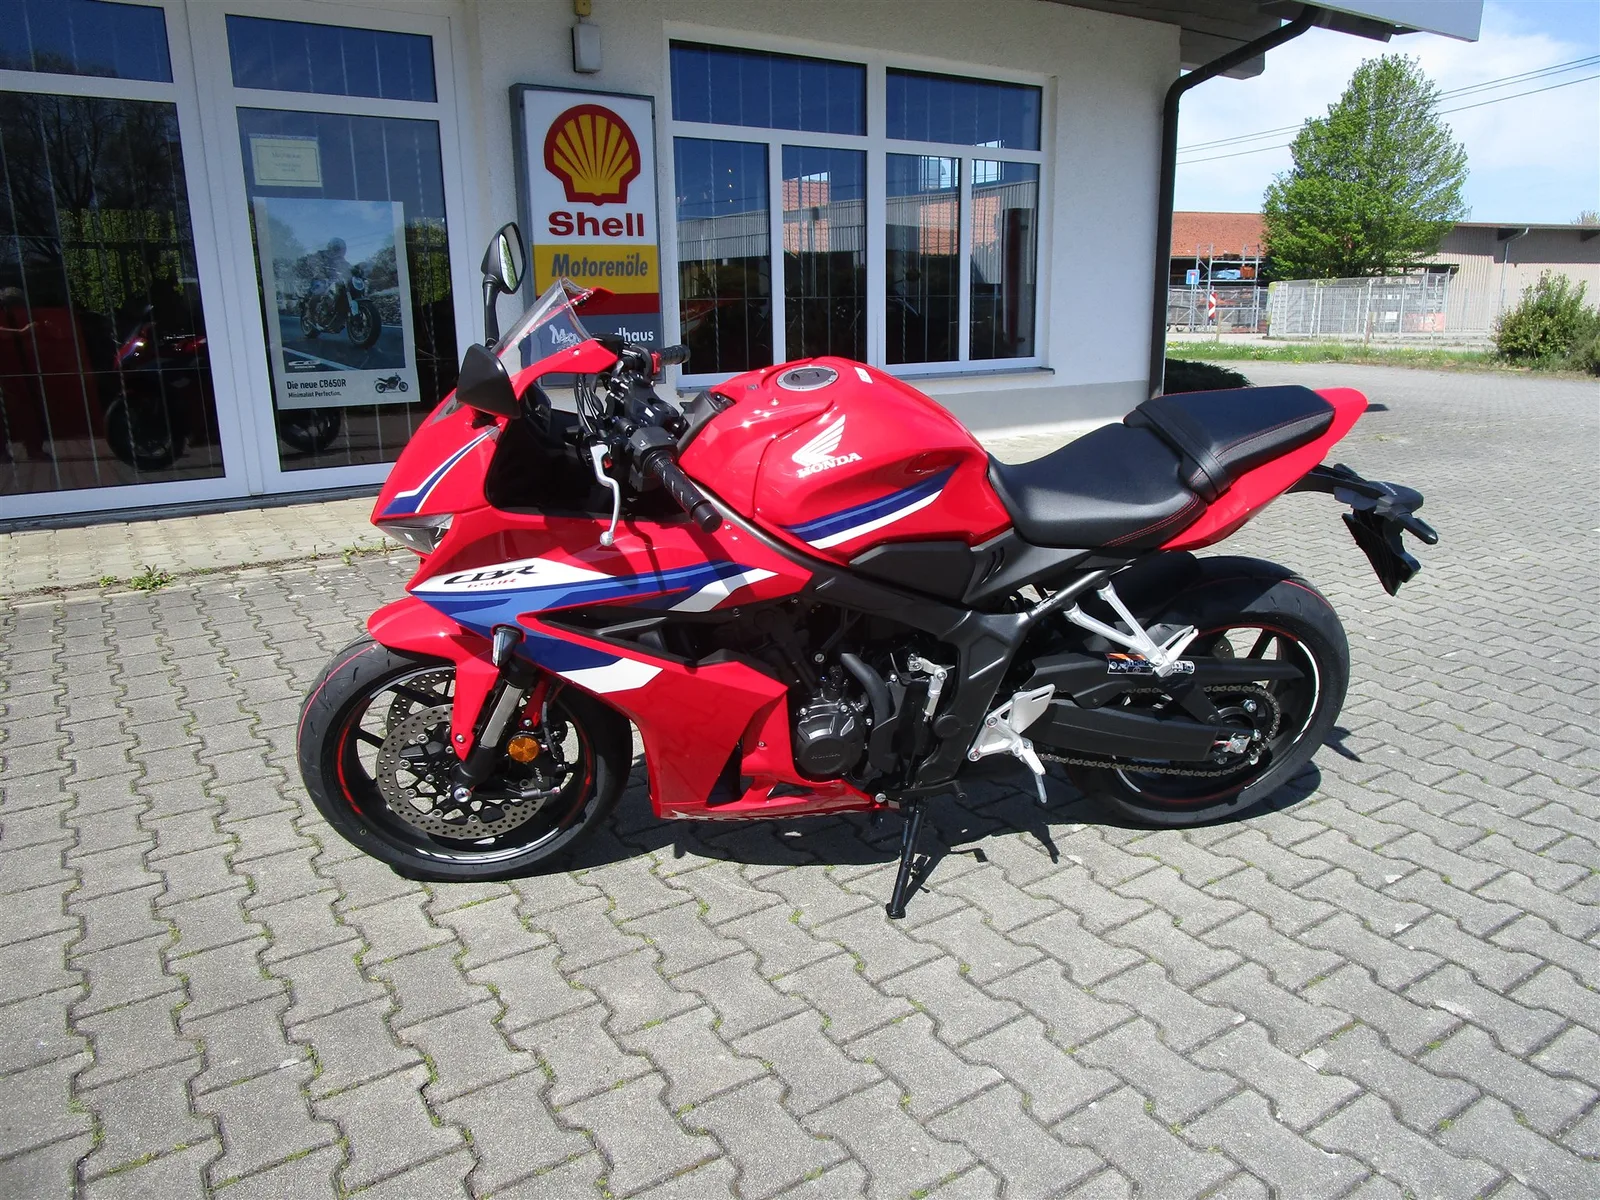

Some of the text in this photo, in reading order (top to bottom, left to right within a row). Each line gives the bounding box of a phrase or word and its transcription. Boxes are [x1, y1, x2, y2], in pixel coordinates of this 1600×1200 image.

[548, 211, 645, 237] Shell
[551, 252, 648, 278] Motorenöle
[287, 379, 347, 390] Die neue CB650R
[796, 452, 863, 478] HONDA
[444, 565, 539, 585] CBR
